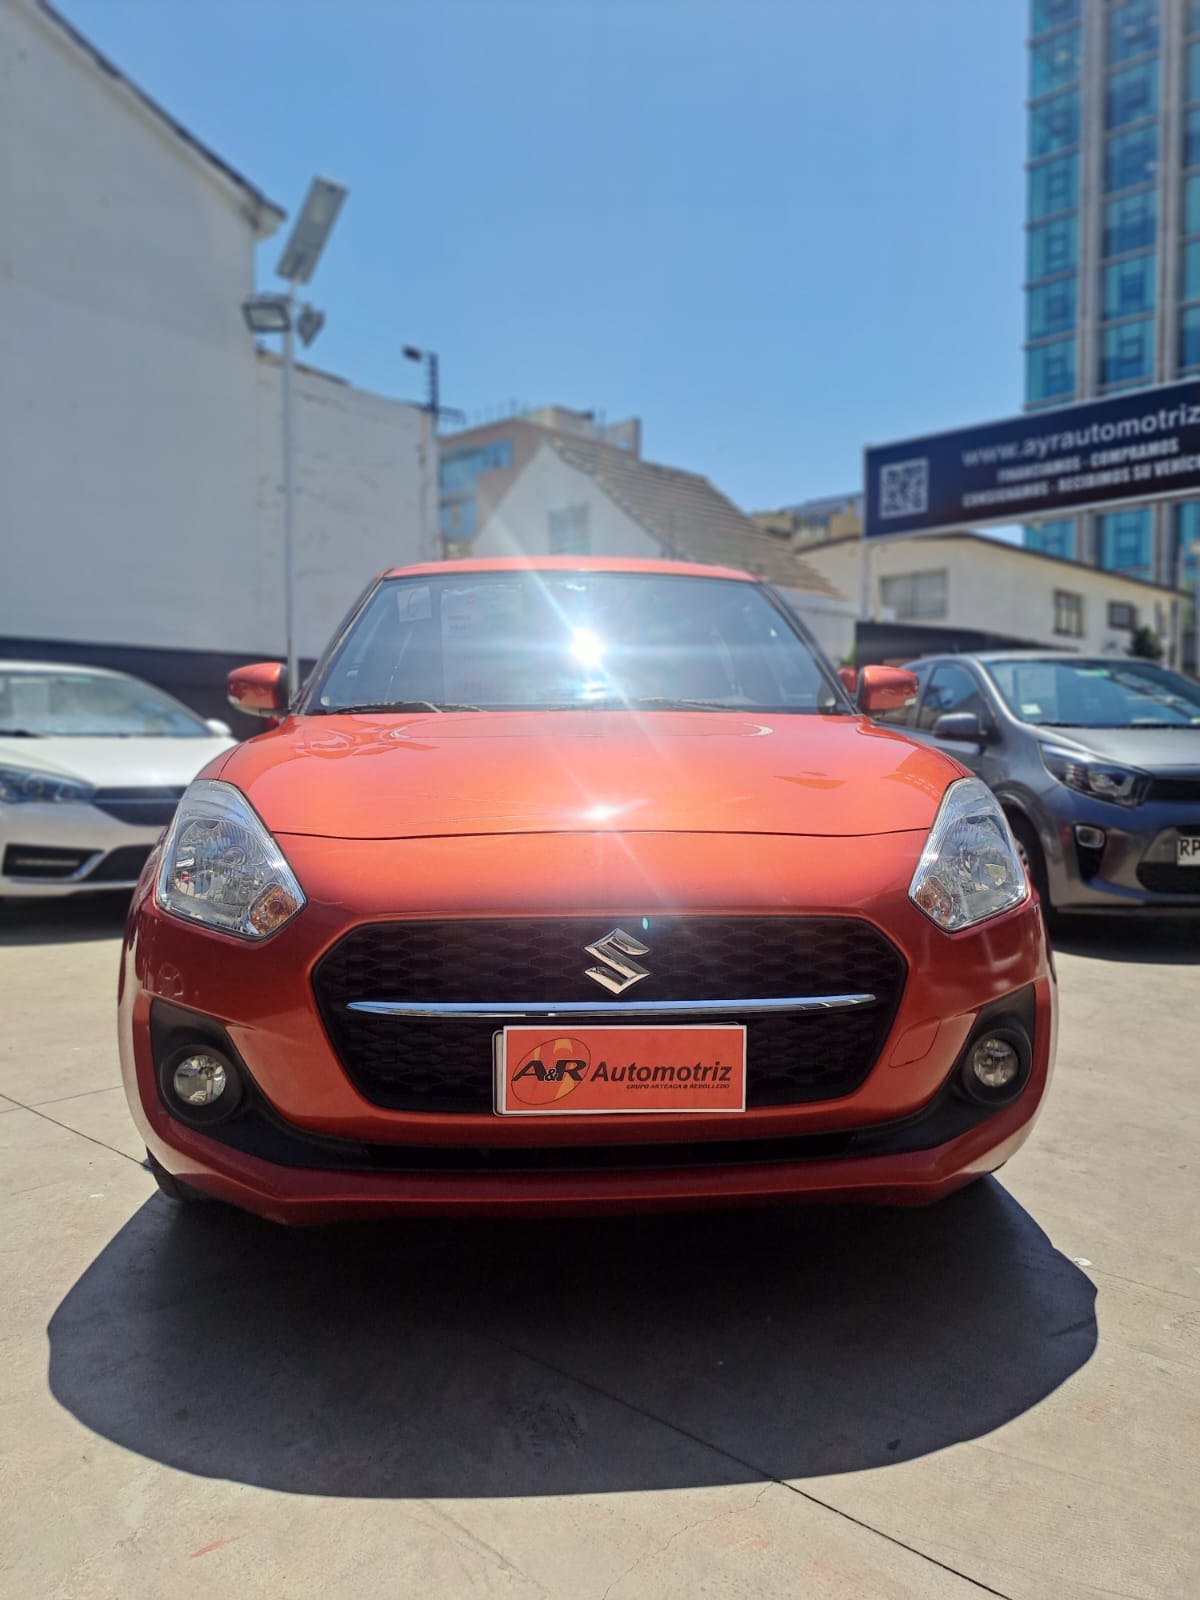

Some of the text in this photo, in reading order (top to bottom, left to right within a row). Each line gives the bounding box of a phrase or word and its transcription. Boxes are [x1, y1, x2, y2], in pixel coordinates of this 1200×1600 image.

[961, 403, 1200, 466] www.ayrautomotriz
[1090, 437, 1179, 467] COMPRAMOS
[1134, 463, 1151, 480] SU
[511, 1059, 732, 1082] A&R Automotriz
